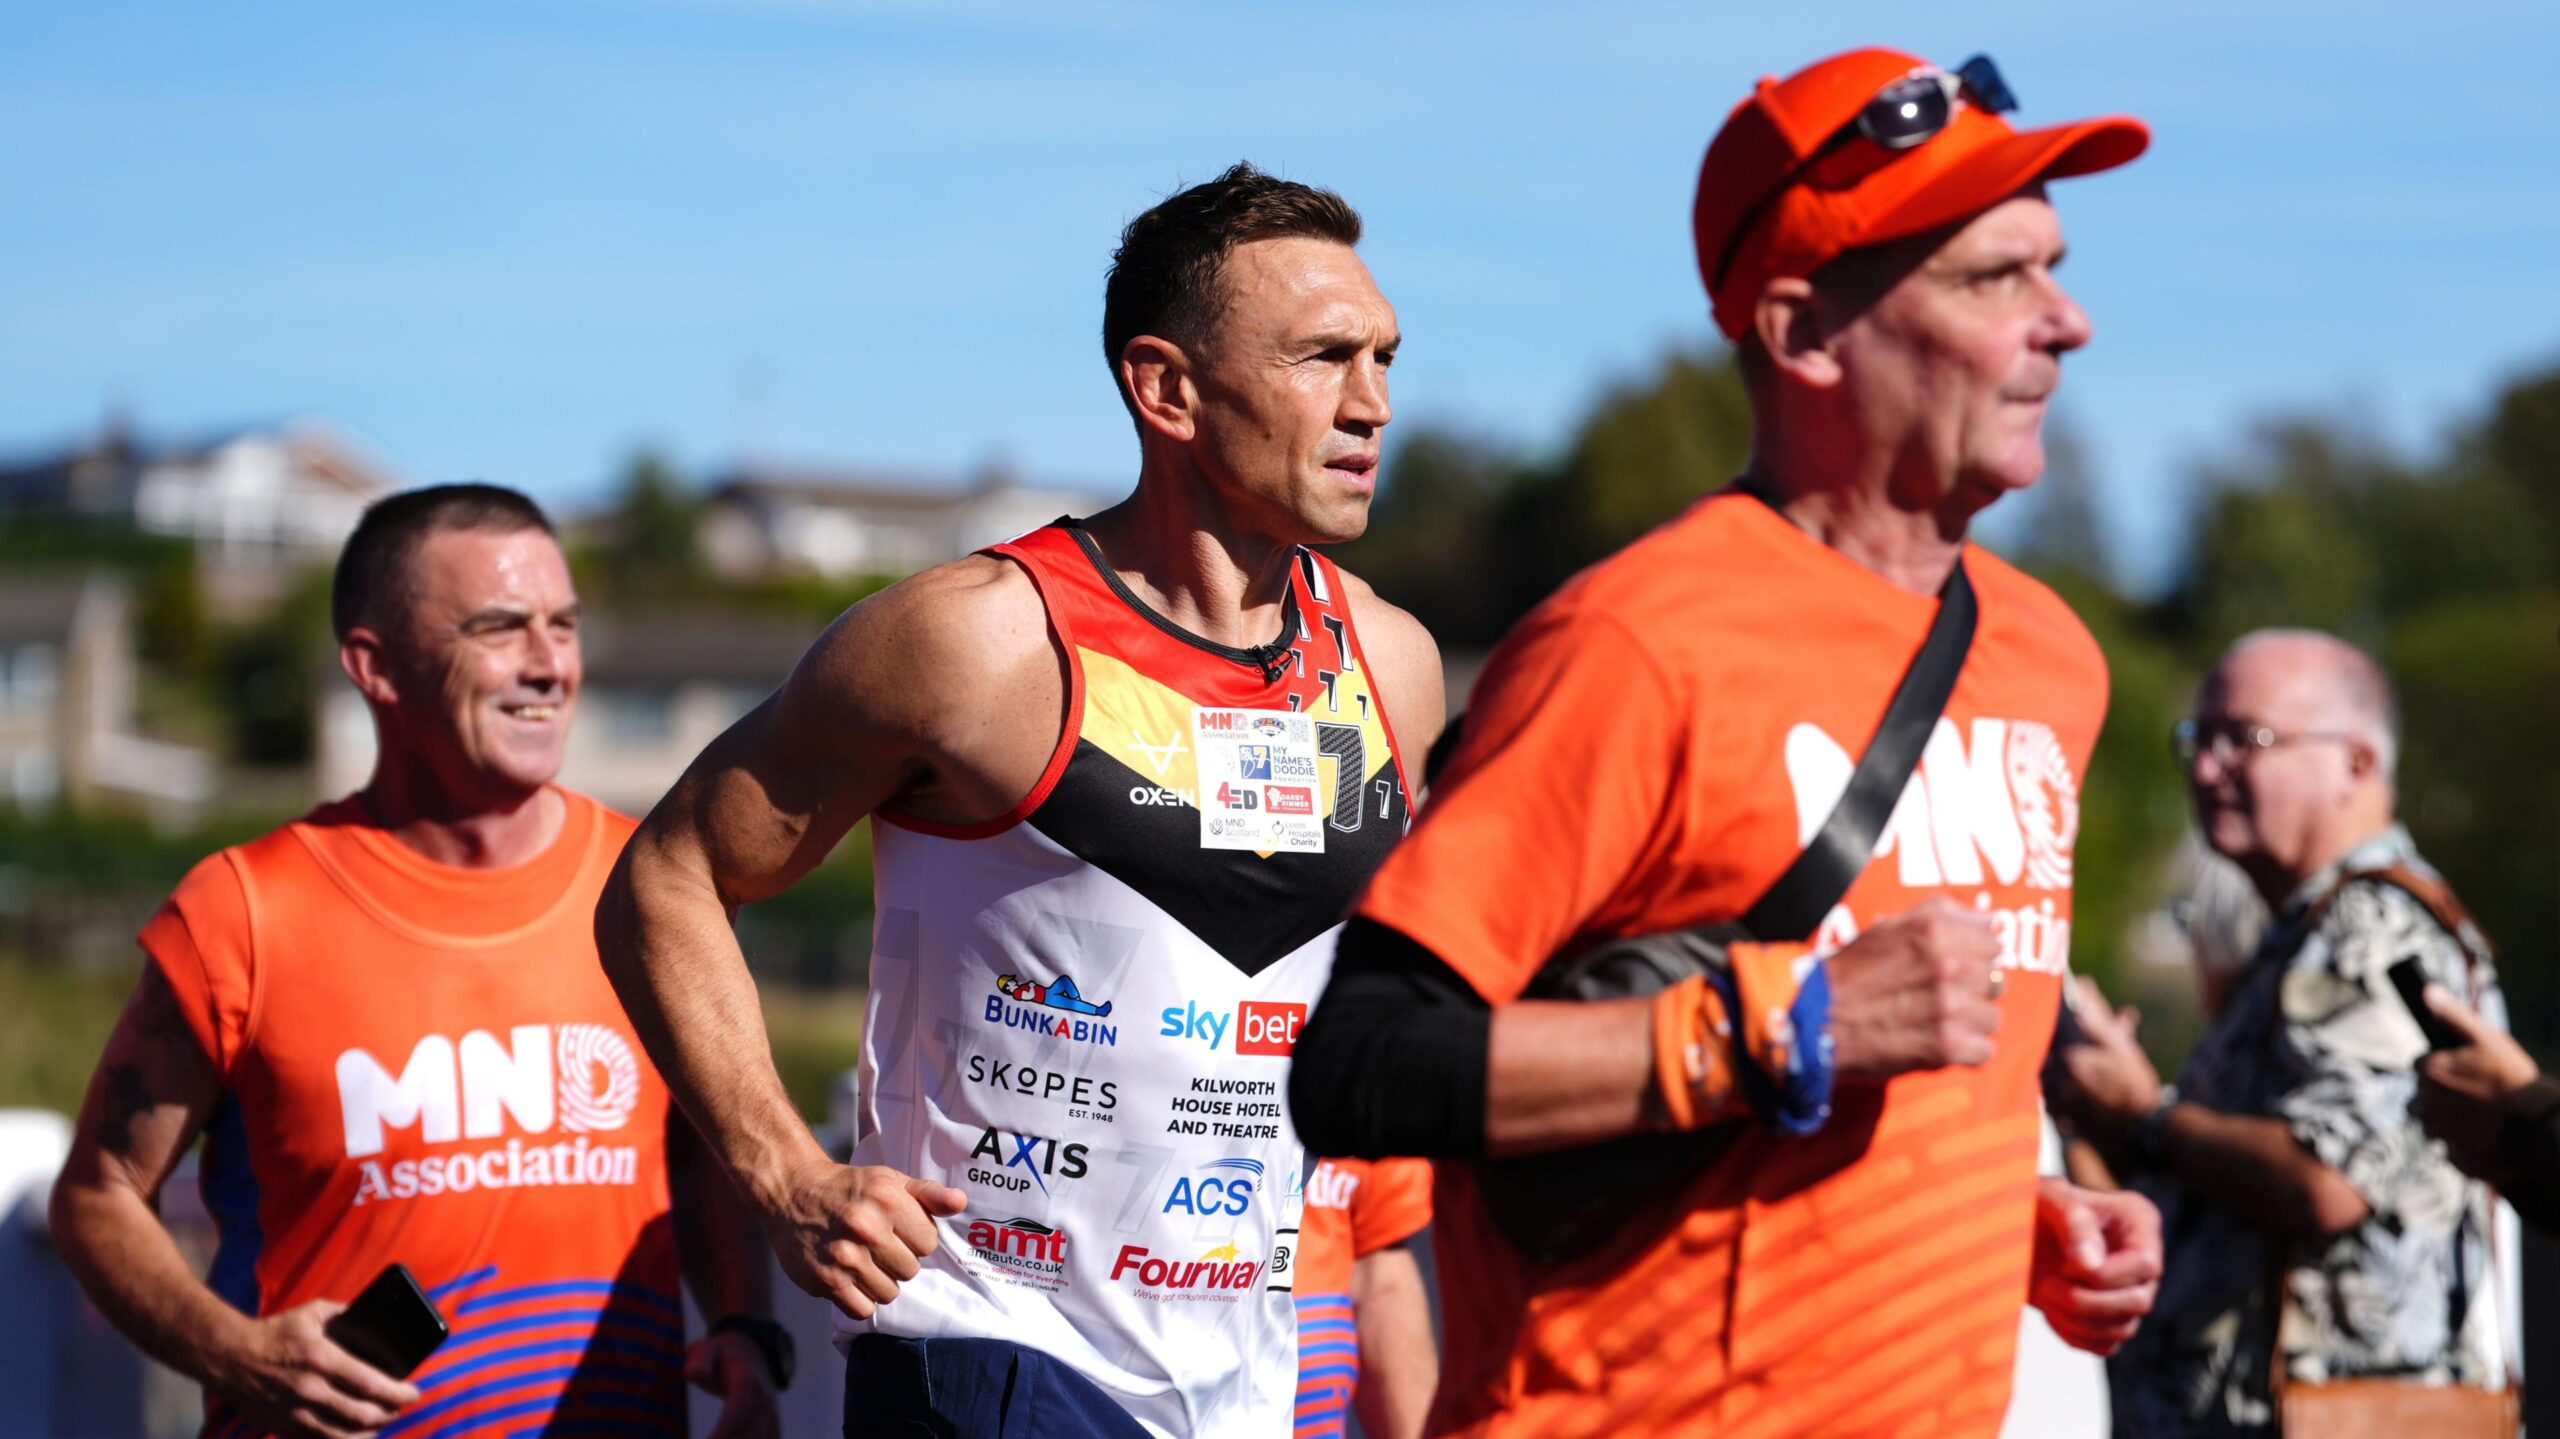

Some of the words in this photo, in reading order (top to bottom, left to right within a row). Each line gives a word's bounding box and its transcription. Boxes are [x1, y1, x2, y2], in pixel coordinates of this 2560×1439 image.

[1200, 712, 1249, 730] MND
[1273, 746, 1287, 755] MY
[1273, 755, 1312, 767] NAME'S
[1274, 765, 1316, 776] DODDIE
[1315, 722, 1365, 833] 7
[1129, 786, 1195, 807] OXEN
[1225, 818, 1246, 827] MND
[1288, 830, 1321, 839] Hospitals
[1290, 837, 1318, 848] Charity
[1160, 1000, 1231, 1050] sky
[1244, 1005, 1299, 1044] bet
[335, 1023, 640, 1159] MND
[967, 1055, 1118, 1109] SKOPES
[1191, 1078, 1276, 1095] KILWORTH
[1068, 1109, 1088, 1119] EST.
[1091, 1112, 1114, 1122] 1948
[1171, 1097, 1233, 1115] HOUSE
[1236, 1103, 1281, 1117] HOTEL
[1166, 1119, 1208, 1135] AND
[1212, 1123, 1279, 1139] THEATRE
[352, 1136, 639, 1207] Association
[970, 1126, 1090, 1198] AXIS
[967, 1167, 1031, 1193] GROUP
[1162, 1176, 1253, 1216] ACS
[967, 1221, 1067, 1263] amt
[966, 1248, 1063, 1274] amtauto.co.uk
[1110, 1245, 1266, 1294] Fourway
[991, 1265, 1022, 1276] solution
[1023, 1271, 1034, 1279] for
[1035, 1275, 1069, 1287] everyone
[1133, 1288, 1160, 1301] We've
[1160, 1293, 1175, 1303] got
[1209, 1294, 1239, 1303] covered
